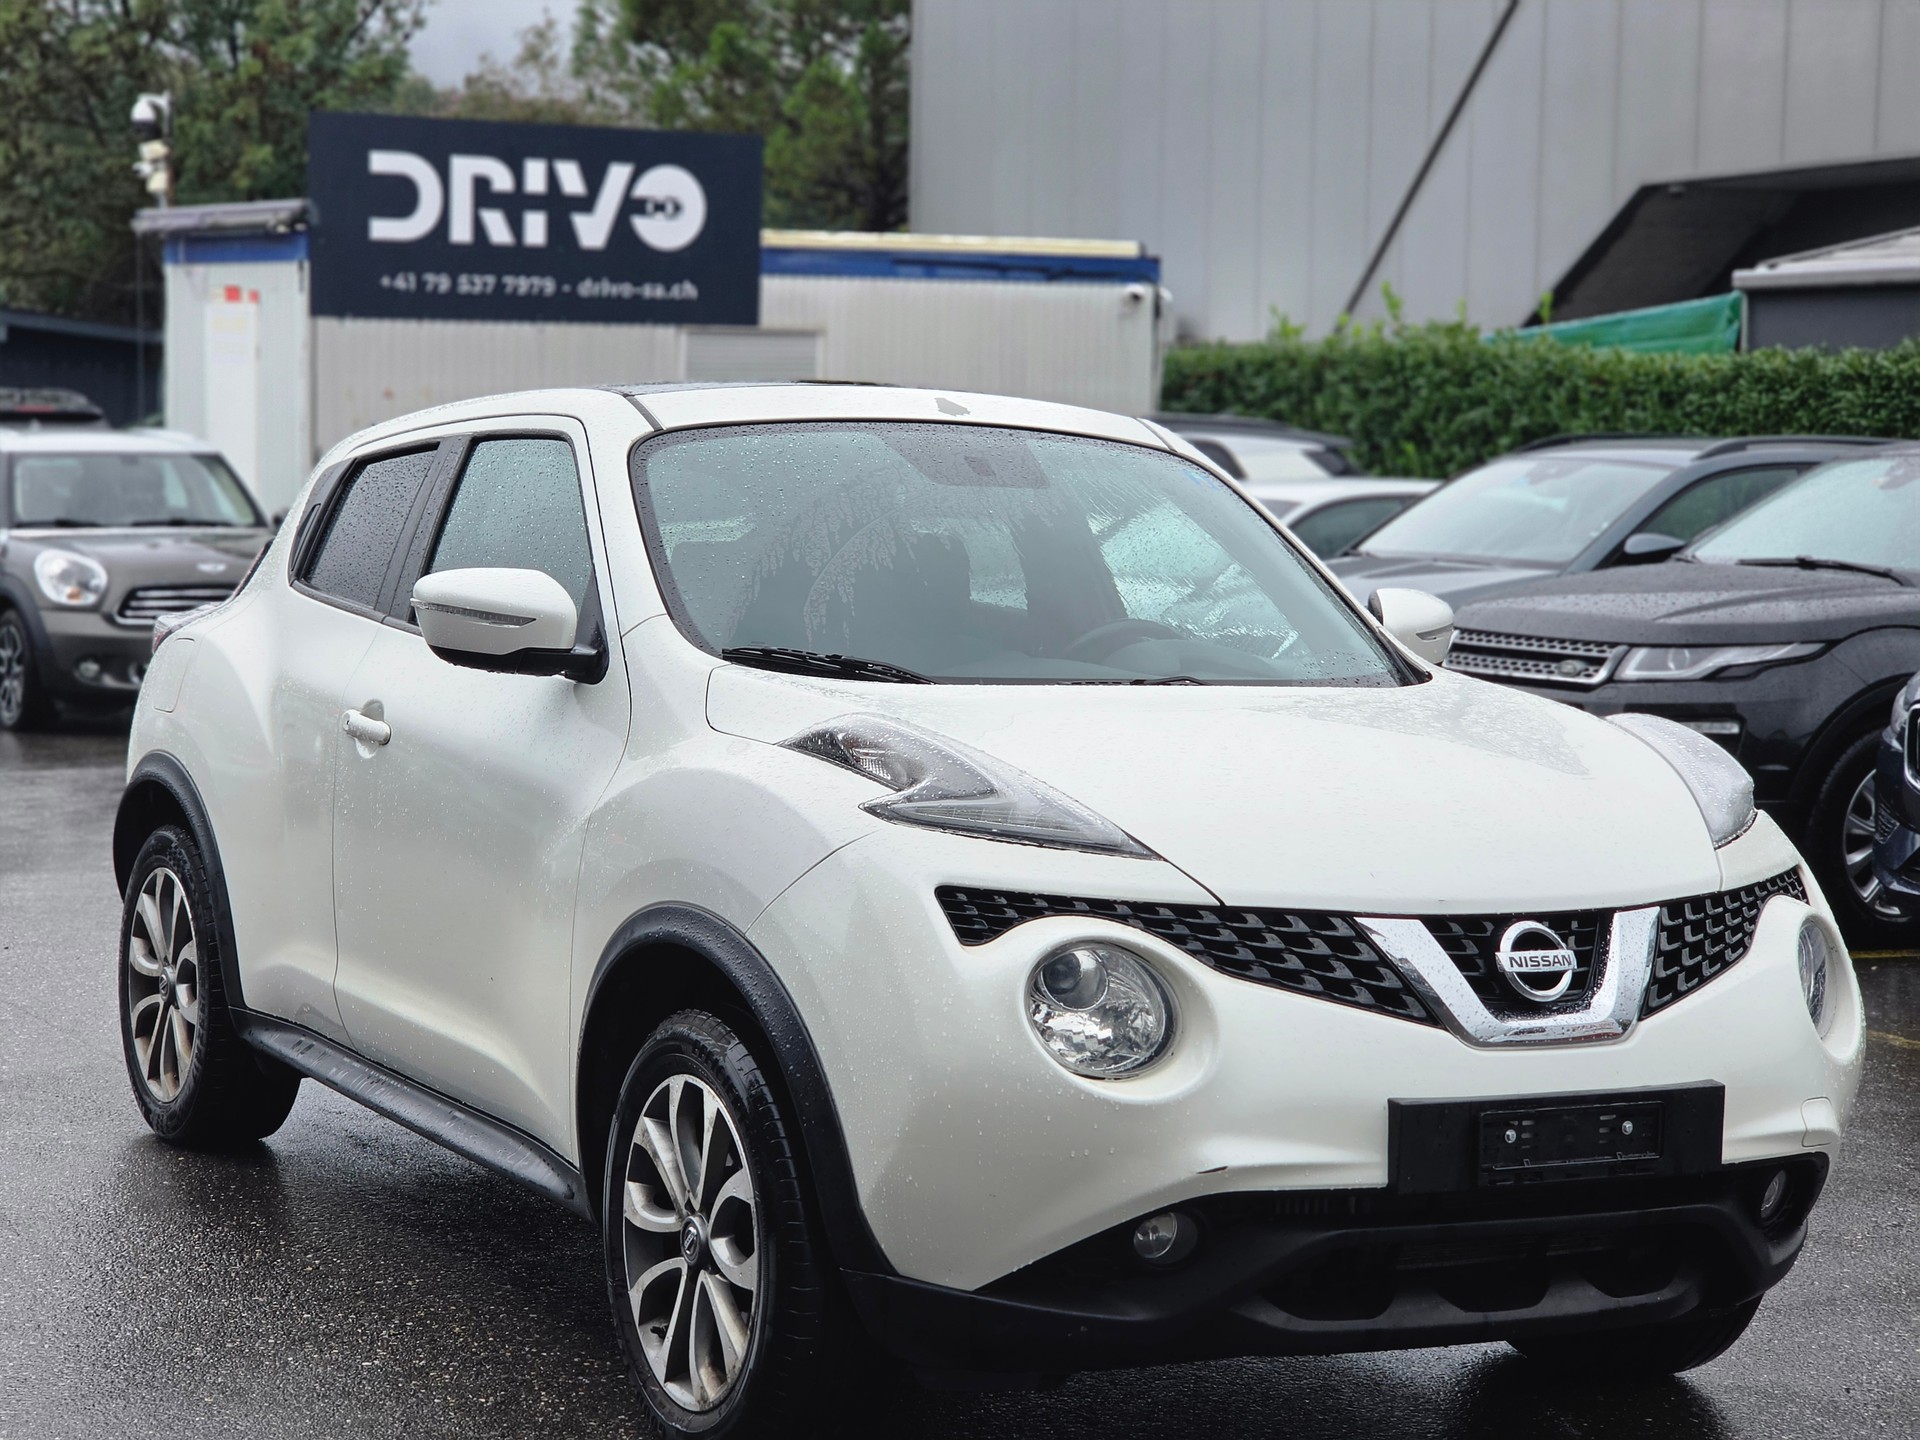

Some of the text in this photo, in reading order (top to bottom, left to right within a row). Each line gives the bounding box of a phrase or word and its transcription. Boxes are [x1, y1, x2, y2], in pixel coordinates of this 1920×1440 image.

[368, 149, 707, 252] DRIVO
[380, 271, 417, 292] +41
[421, 272, 451, 294] 79
[456, 273, 497, 295] 537
[501, 274, 556, 297] 7979
[577, 276, 698, 300] drivo-sa.ch
[1508, 954, 1573, 968] NISSAN
